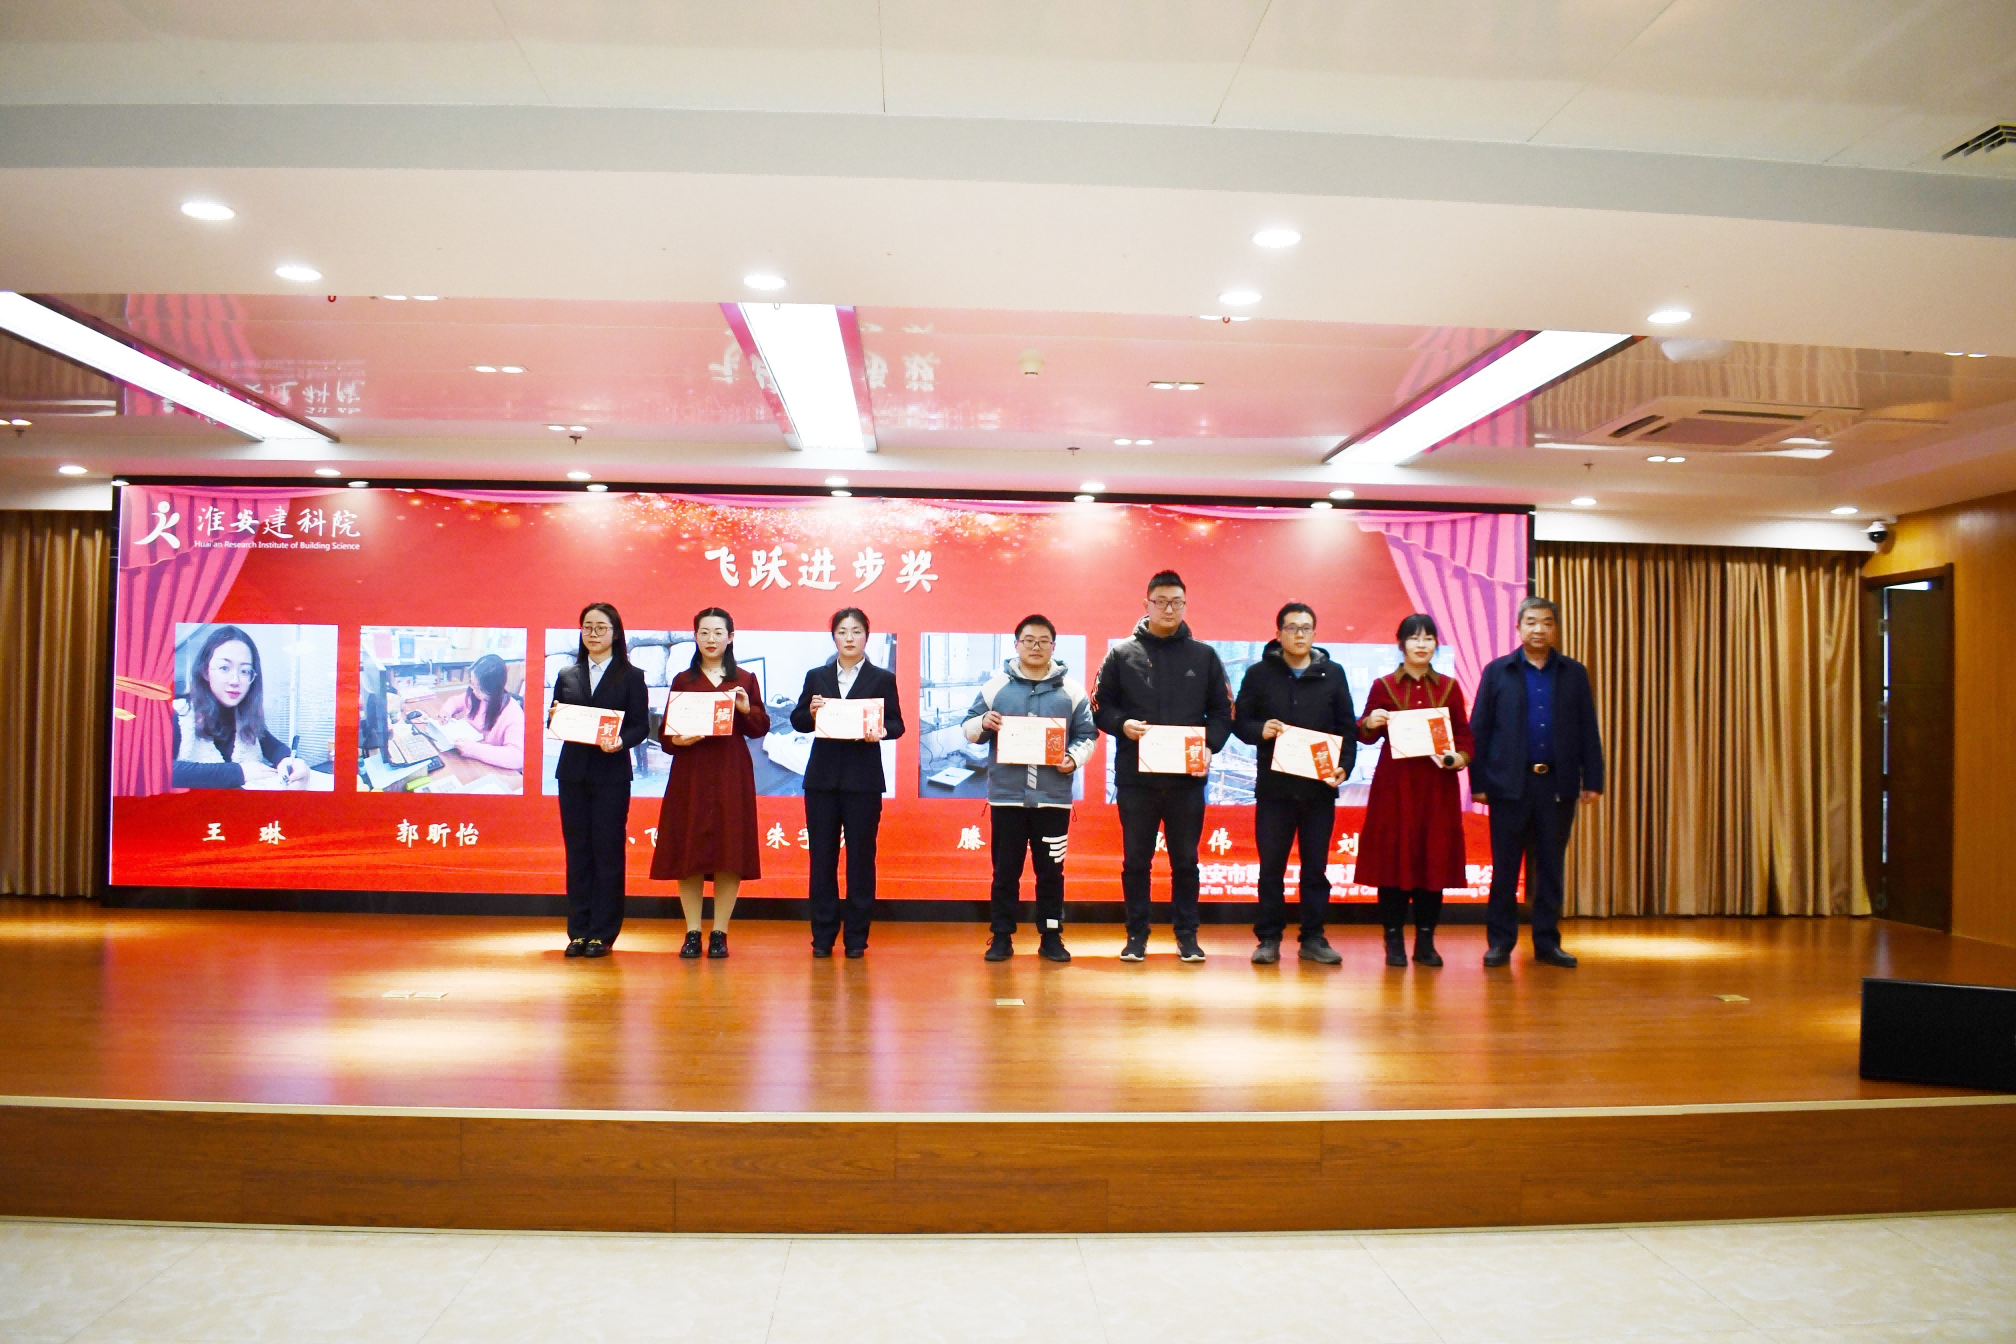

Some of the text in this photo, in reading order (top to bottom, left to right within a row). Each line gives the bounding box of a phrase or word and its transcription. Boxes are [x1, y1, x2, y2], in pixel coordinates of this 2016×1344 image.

[197, 505, 361, 539] 淮安建科院
[224, 540, 257, 550] Research
[258, 541, 289, 549] Institute
[290, 541, 299, 549] of
[300, 541, 331, 551] Building
[332, 541, 361, 550] Science
[704, 546, 939, 593] 飞跃进步奖
[396, 818, 479, 848] 郭昕怡
